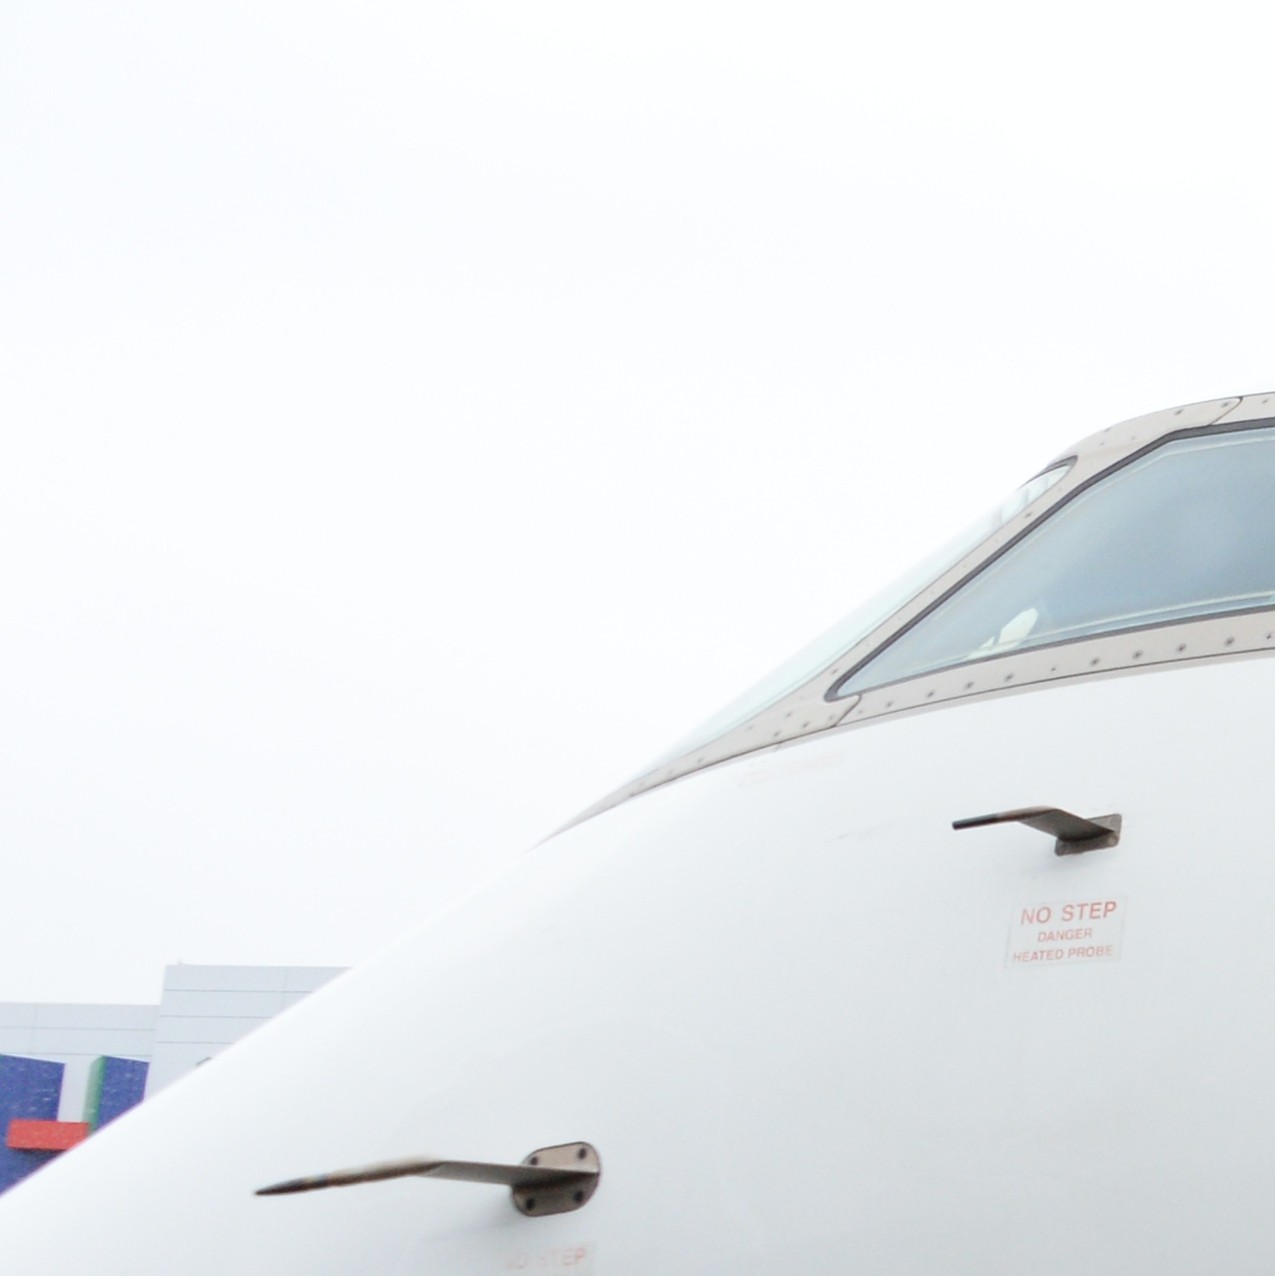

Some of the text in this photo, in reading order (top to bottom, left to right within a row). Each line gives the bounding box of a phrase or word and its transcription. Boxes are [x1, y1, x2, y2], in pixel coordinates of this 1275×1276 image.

[1020, 900, 1117, 925] NO STEP
[1037, 927, 1093, 943] DANGER
[1013, 944, 1113, 962] HEATED PROBE
